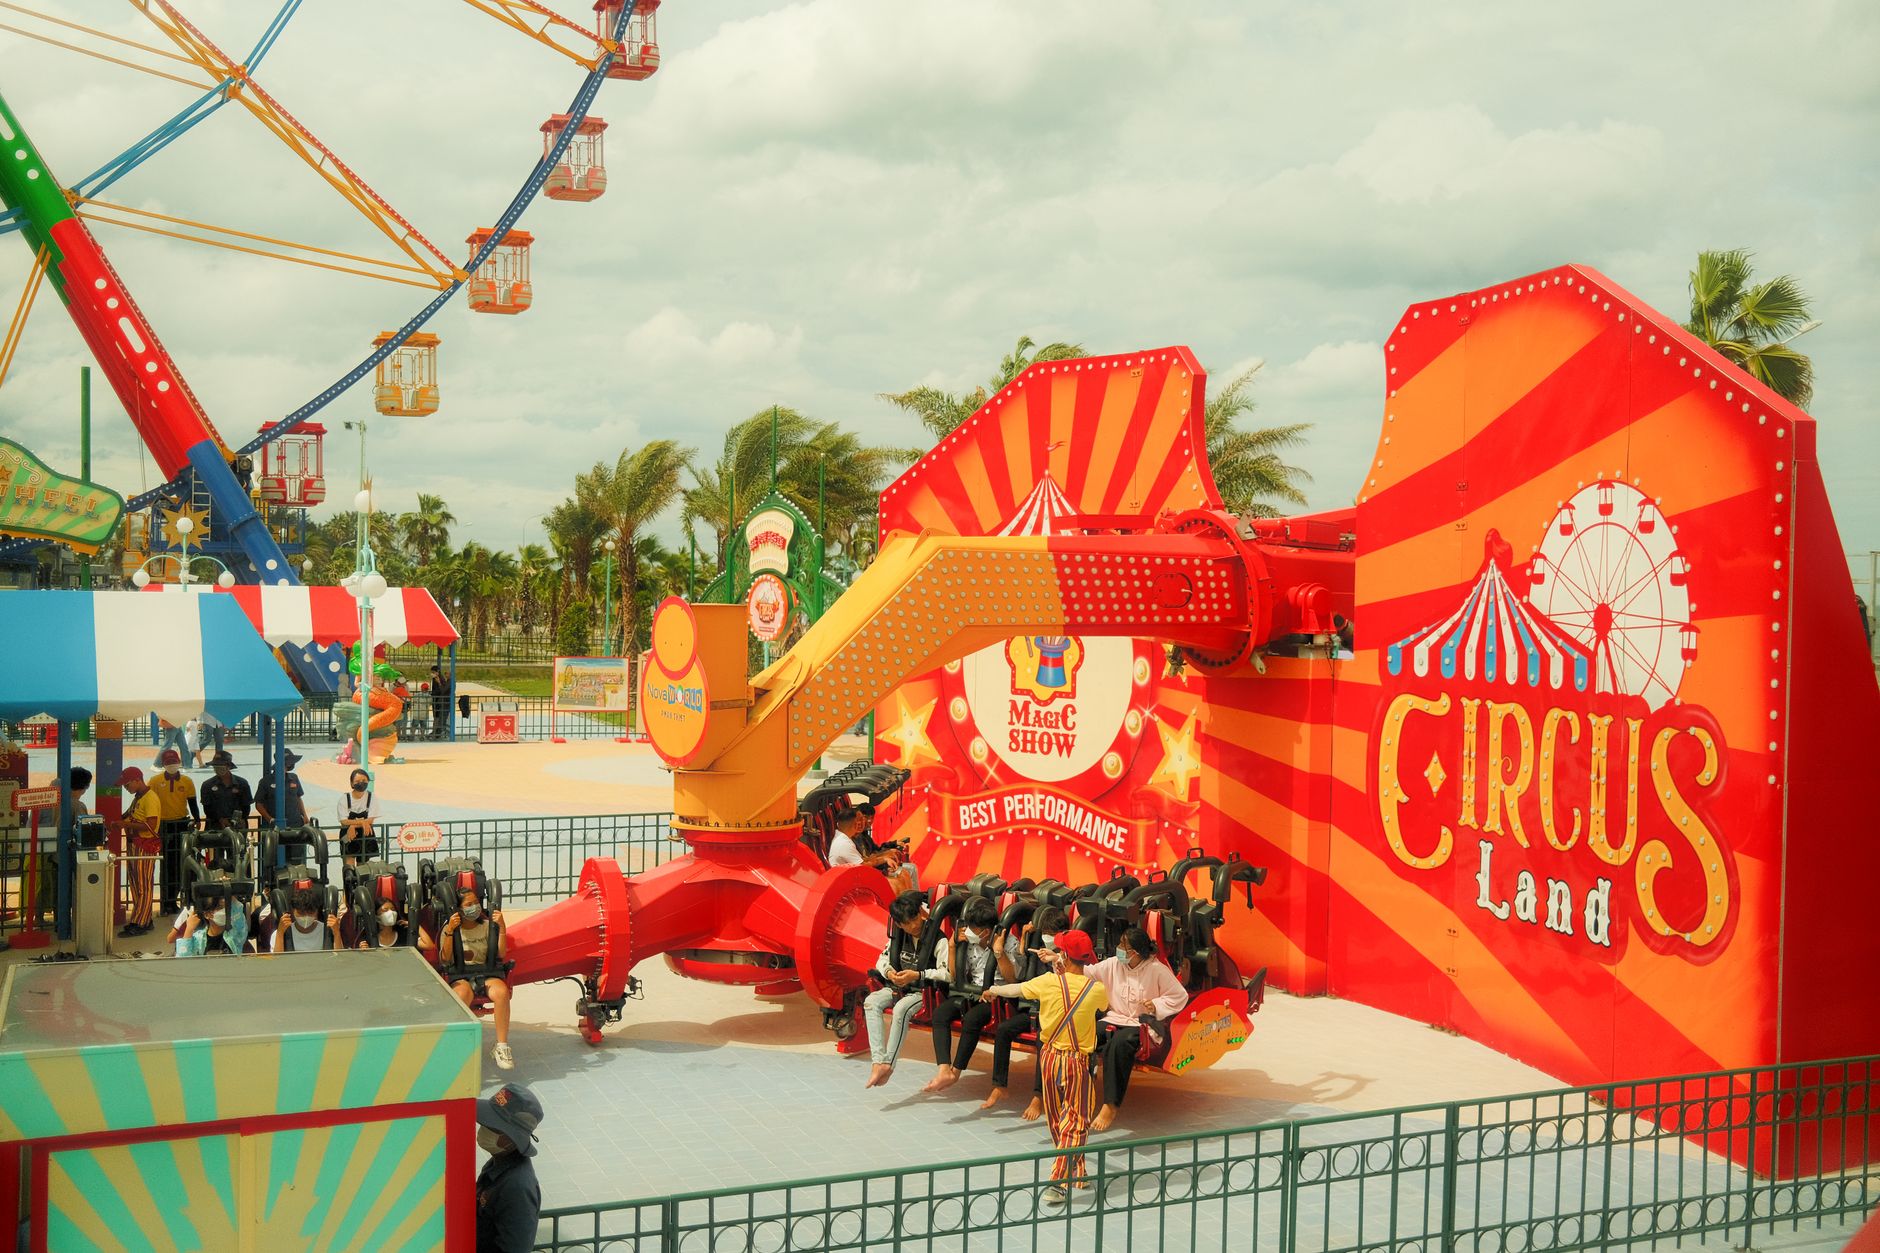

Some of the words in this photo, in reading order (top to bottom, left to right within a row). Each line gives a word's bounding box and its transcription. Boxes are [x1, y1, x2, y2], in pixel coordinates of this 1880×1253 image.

[1008, 728, 1077, 759] SHOW
[959, 798, 997, 830] BEST
[1003, 793, 1129, 854] PERFORMANCE
[1379, 692, 1729, 946] CIRCUS
[1475, 839, 1612, 947] Land
